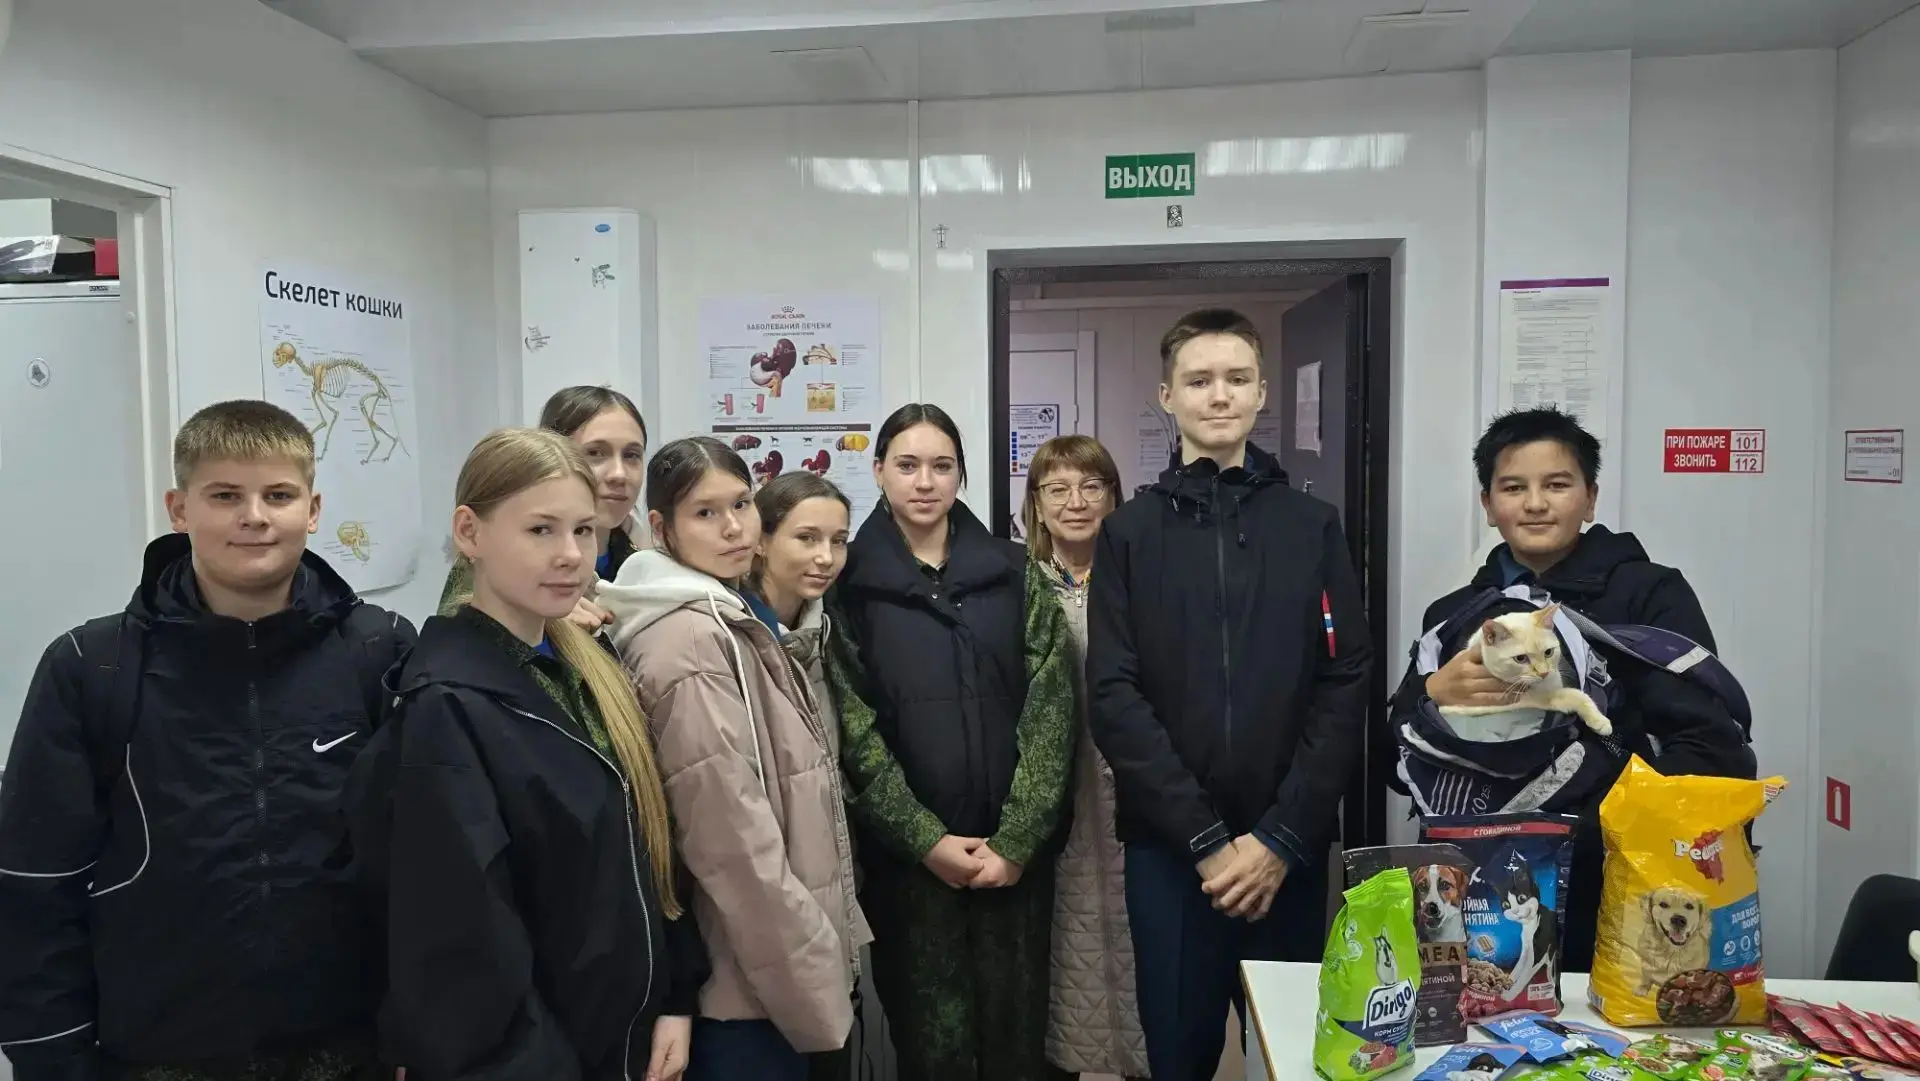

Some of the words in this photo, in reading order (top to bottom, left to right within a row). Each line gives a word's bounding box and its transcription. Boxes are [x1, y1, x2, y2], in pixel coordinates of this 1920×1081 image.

[1109, 164, 1191, 190] ВЫХОД
[265, 271, 340, 308] Скелет
[345, 293, 403, 319] кошки
[1666, 435, 1684, 449] ПРИ
[1687, 435, 1726, 449] ПОЖАРЕ
[1736, 436, 1758, 449] 101
[1673, 453, 1717, 467] ЗВОНИТЬ
[1735, 458, 1757, 470] 112
[1370, 986, 1412, 1021] Dingo
